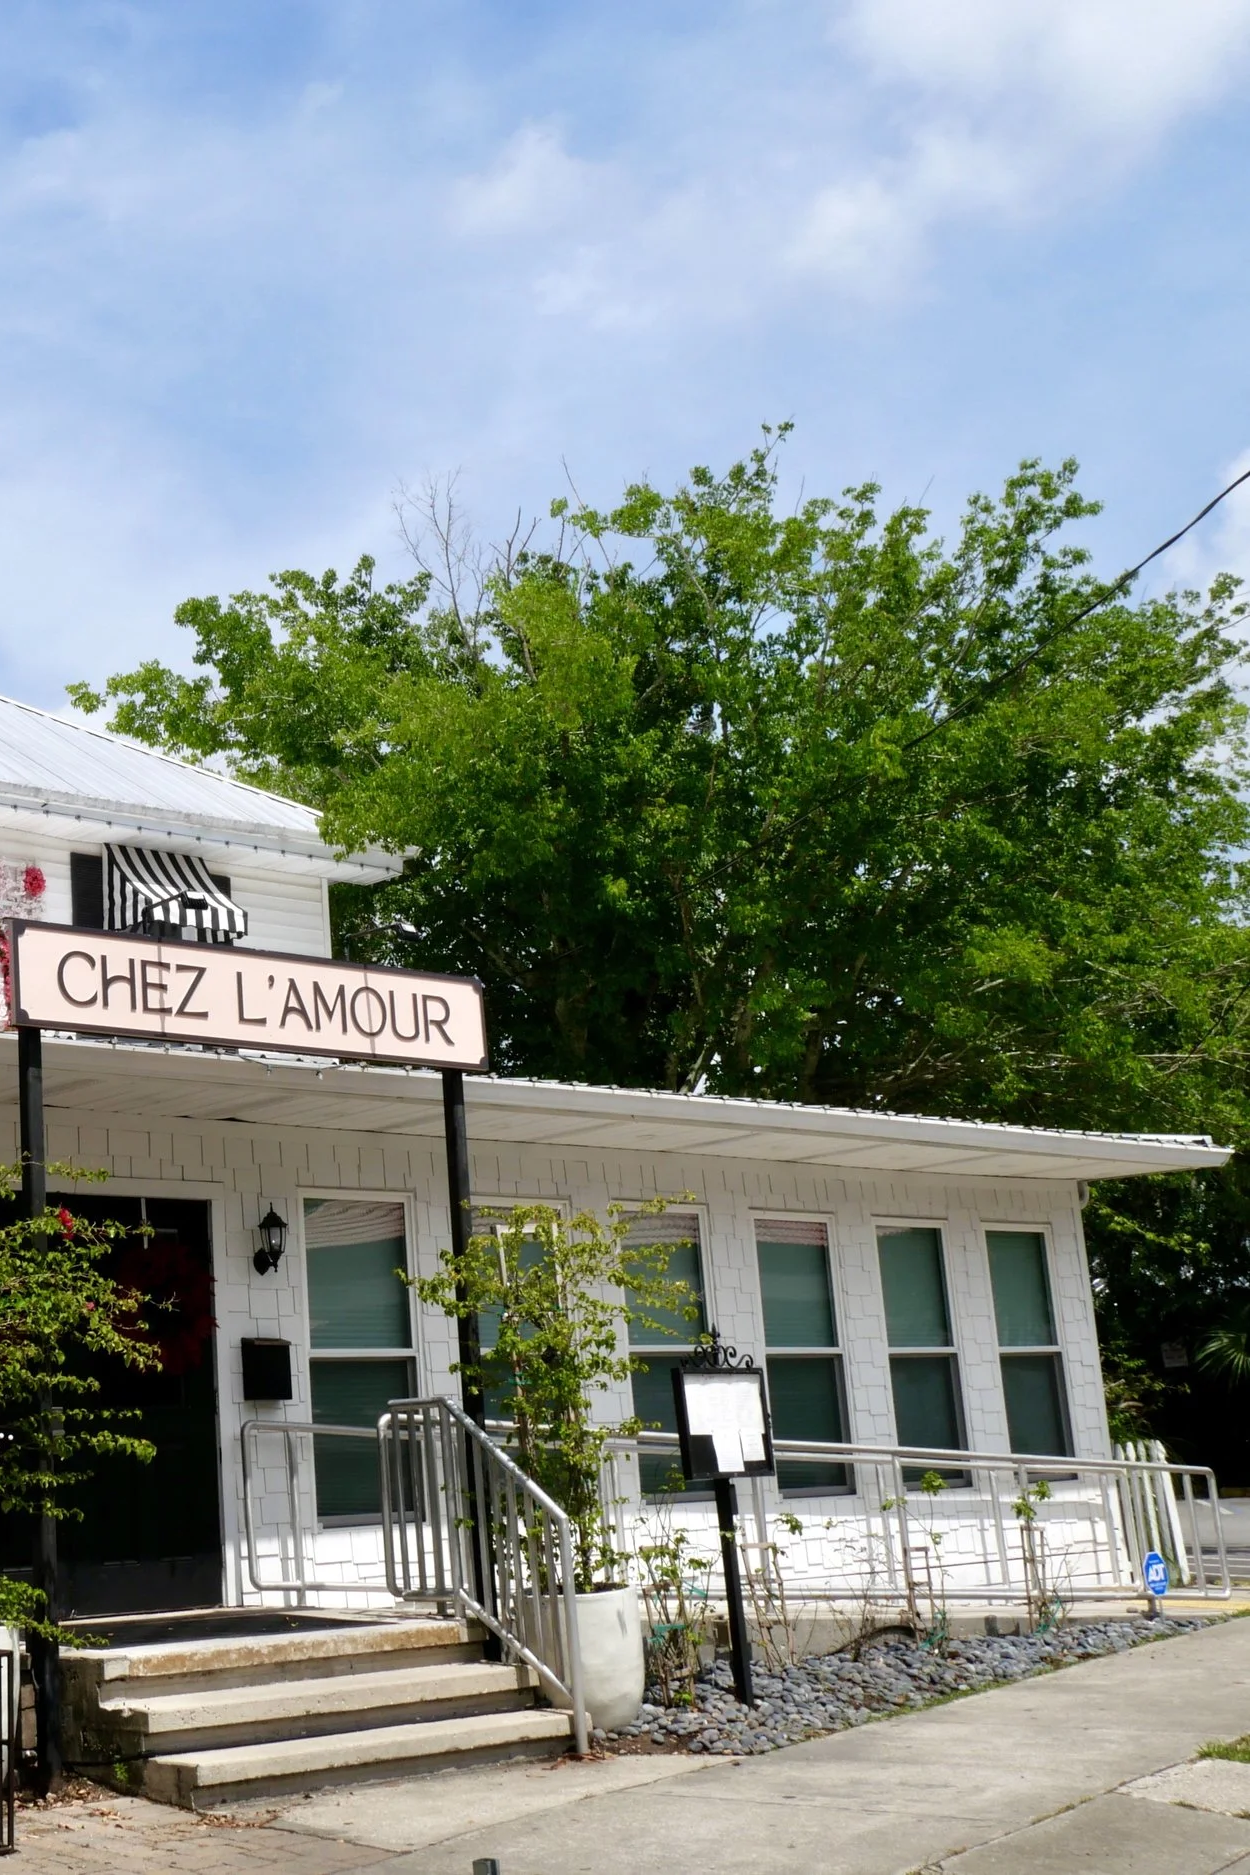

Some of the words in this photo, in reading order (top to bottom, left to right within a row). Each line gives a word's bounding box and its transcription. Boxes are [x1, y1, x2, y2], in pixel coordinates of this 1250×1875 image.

[57, 951, 208, 1018] CHEZ
[236, 971, 455, 1045] L'AMOUR
[1148, 1563, 1165, 1582] ADT
